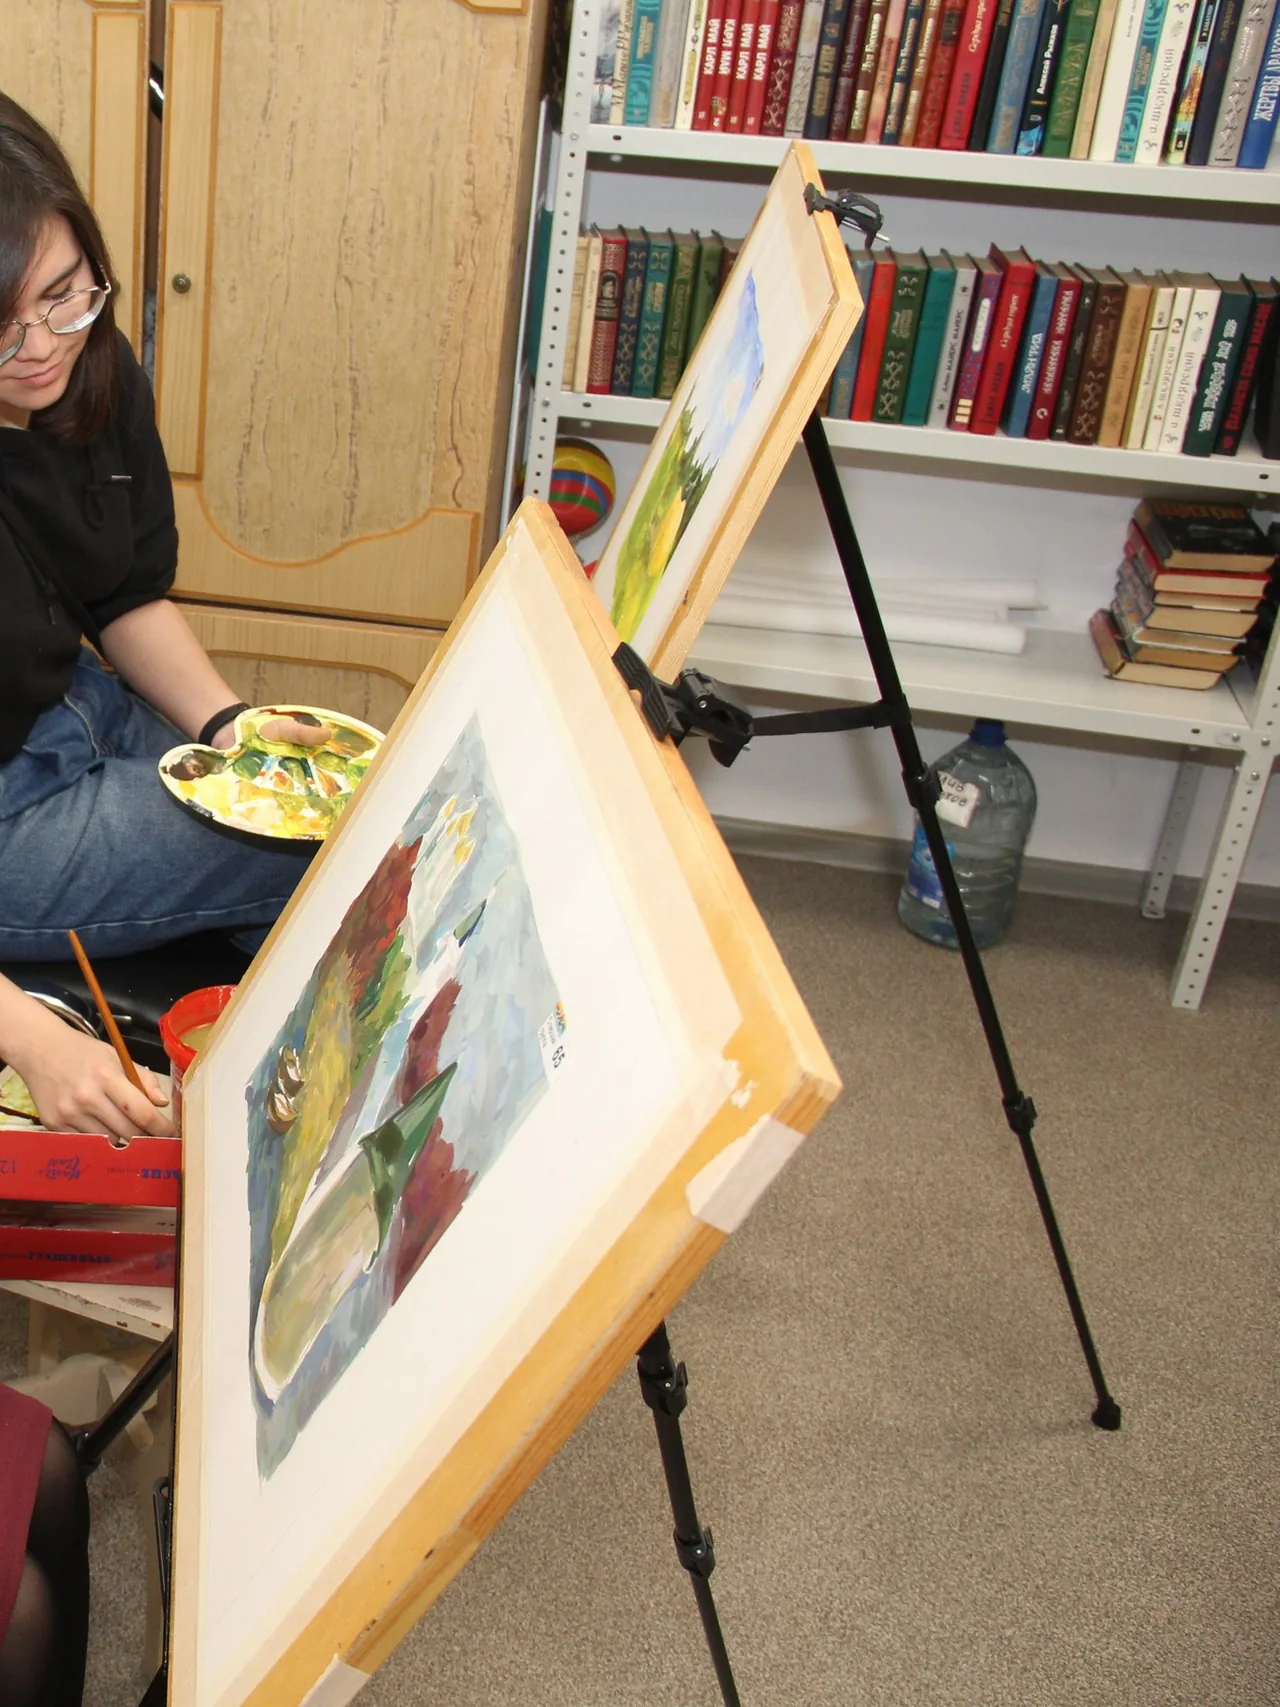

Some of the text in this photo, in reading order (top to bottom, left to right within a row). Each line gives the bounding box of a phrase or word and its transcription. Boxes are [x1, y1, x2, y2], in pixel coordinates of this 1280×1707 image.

[703, 18, 720, 75] КАРЛ МАЙ
[718, 19, 737, 76] КАРЛ МАЙ
[735, 23, 754, 80] КАРЛ МАЙ
[752, 24, 771, 81] КАРЛ МАЙ
[1253, 67, 1274, 121] ЖЕРТВЫ
